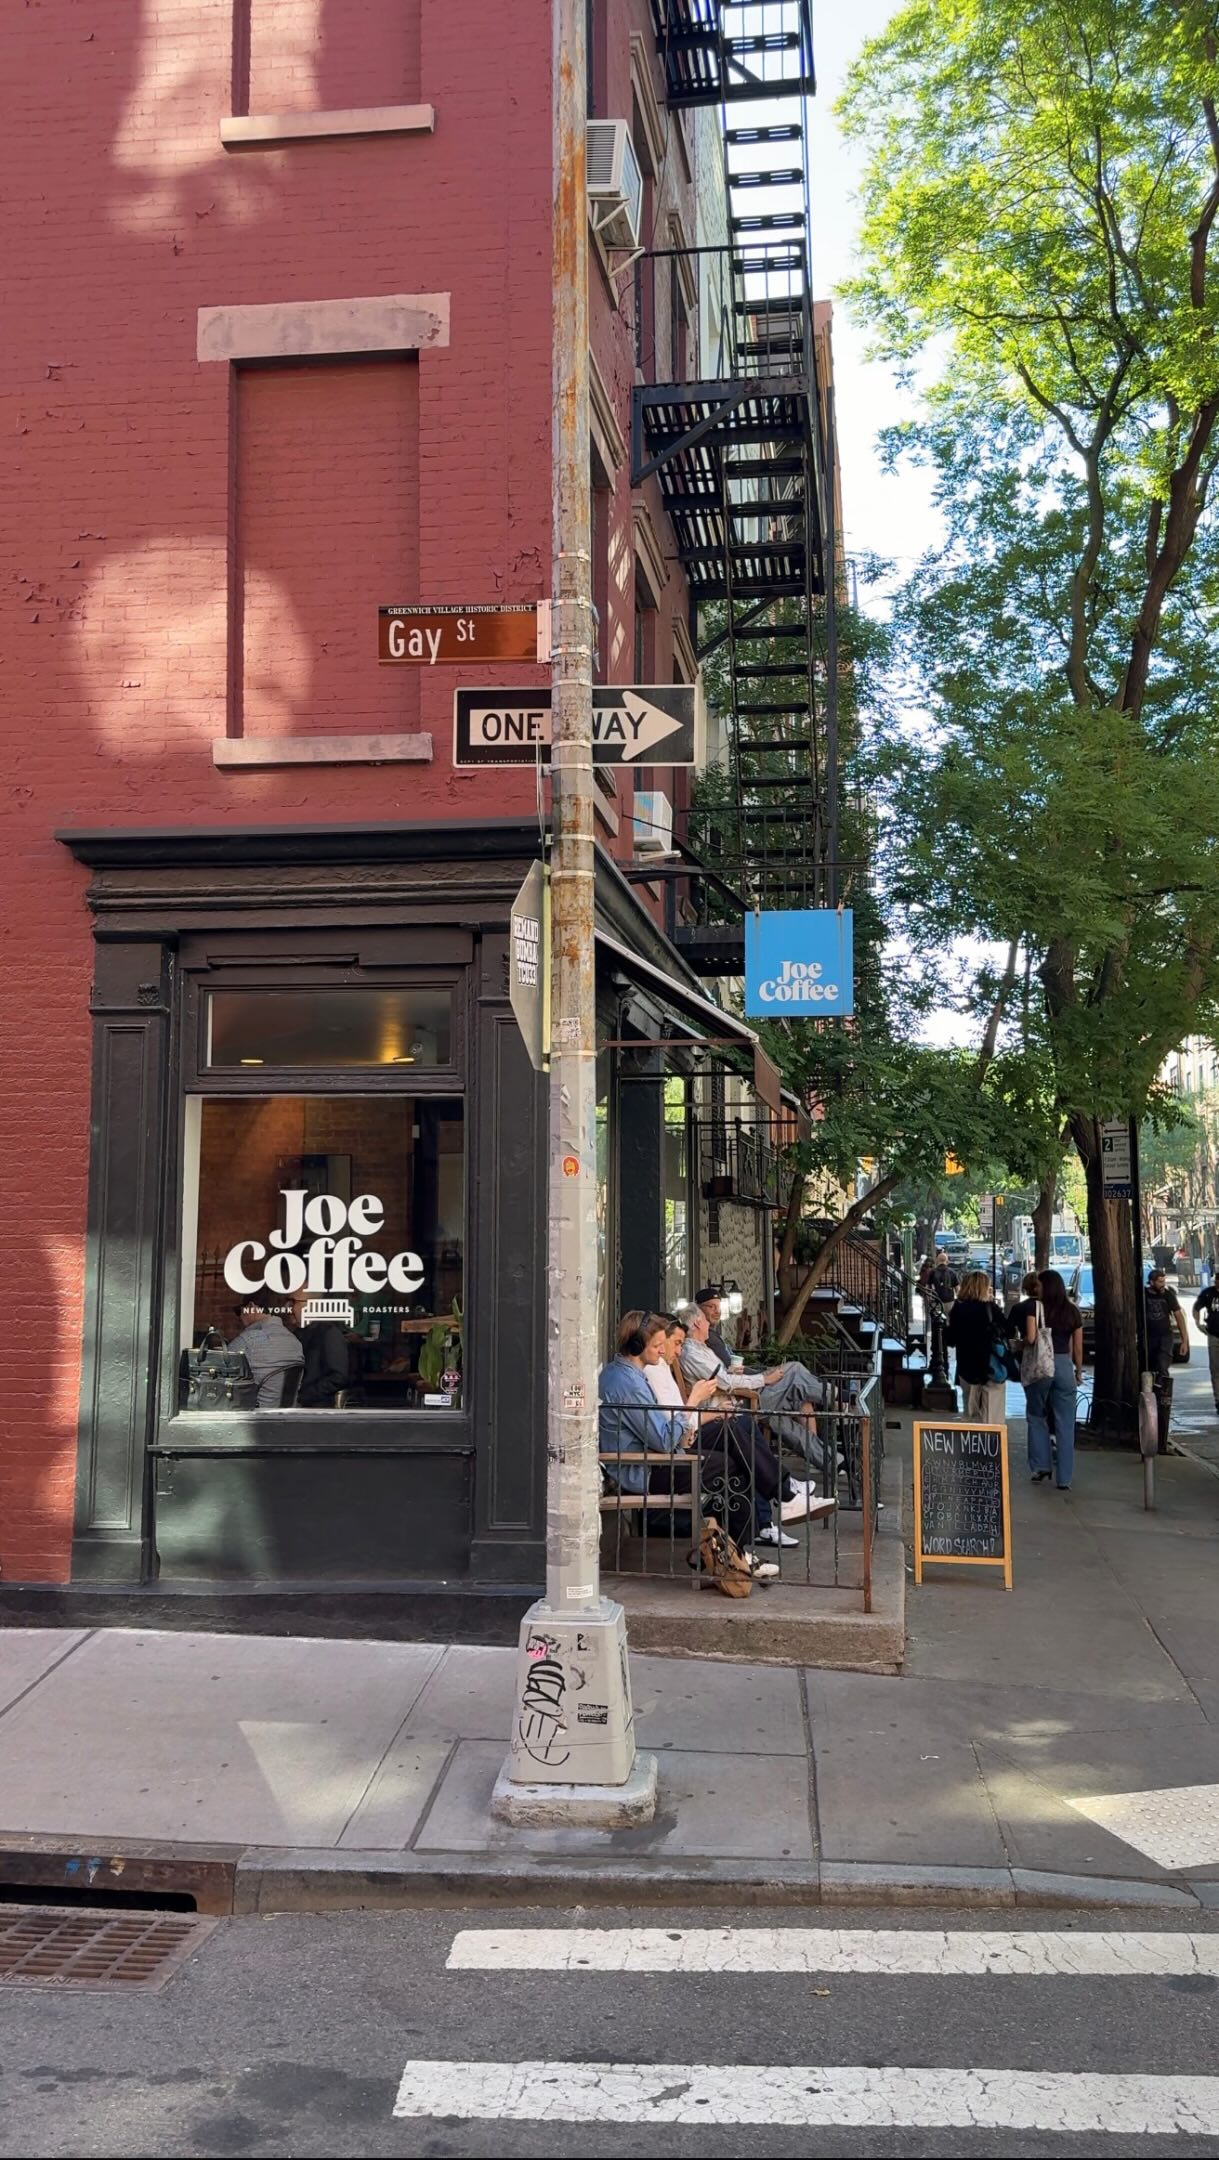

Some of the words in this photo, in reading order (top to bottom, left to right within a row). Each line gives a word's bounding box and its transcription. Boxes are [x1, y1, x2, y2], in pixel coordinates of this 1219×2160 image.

[388, 607, 431, 615] GREENWICH
[433, 606, 464, 614] VILLAGE
[465, 605, 499, 613] HISTORIC
[500, 604, 533, 613] DISTRICT
[388, 619, 443, 665] Gay
[456, 618, 476, 642] St
[481, 712, 544, 742] ONE
[776, 960, 823, 985] Joe
[758, 978, 839, 1002] Coffee
[1104, 1138, 1111, 1151] 2
[268, 1189, 385, 1250] Joe
[223, 1236, 426, 1295] Coffee
[1012, 1274, 1018, 1283] P
[268, 1306, 293, 1314] YORK
[362, 1306, 410, 1314] ROASTERS
[923, 1430, 955, 1455] NEW
[960, 1431, 999, 1457] MENU
[922, 1536, 952, 1555] WORD
